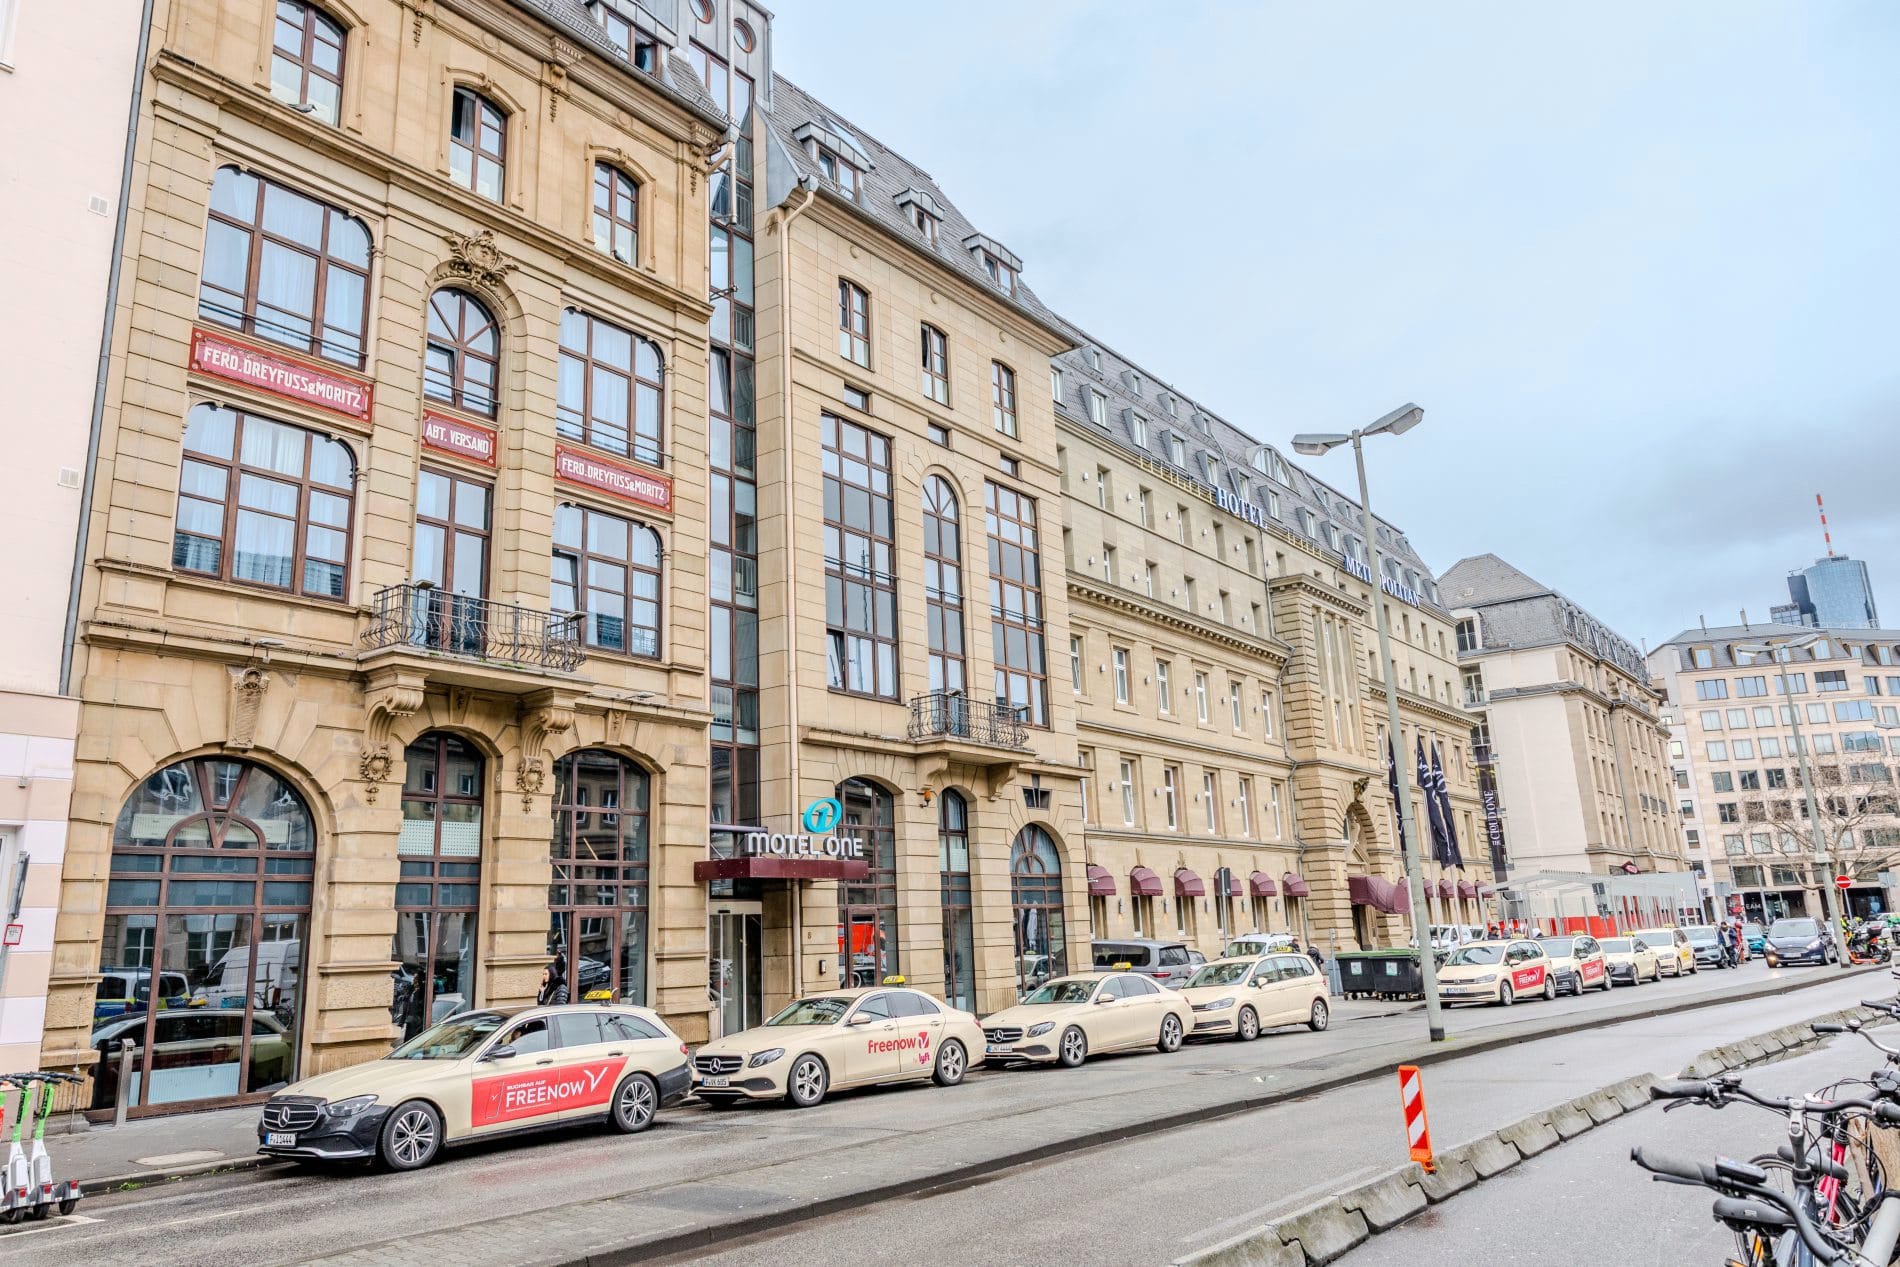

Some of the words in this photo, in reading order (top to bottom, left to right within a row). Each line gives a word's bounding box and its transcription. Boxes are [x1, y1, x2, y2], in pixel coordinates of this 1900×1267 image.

[426, 423, 447, 442] ABT.
[450, 429, 489, 454] VERSAND
[1216, 487, 1268, 529] HOTEL
[1345, 554, 1420, 608] METPOLITAN
[747, 833, 820, 856] MOTEL
[825, 836, 864, 857] ONE
[506, 1080, 585, 1108] FREENOW
